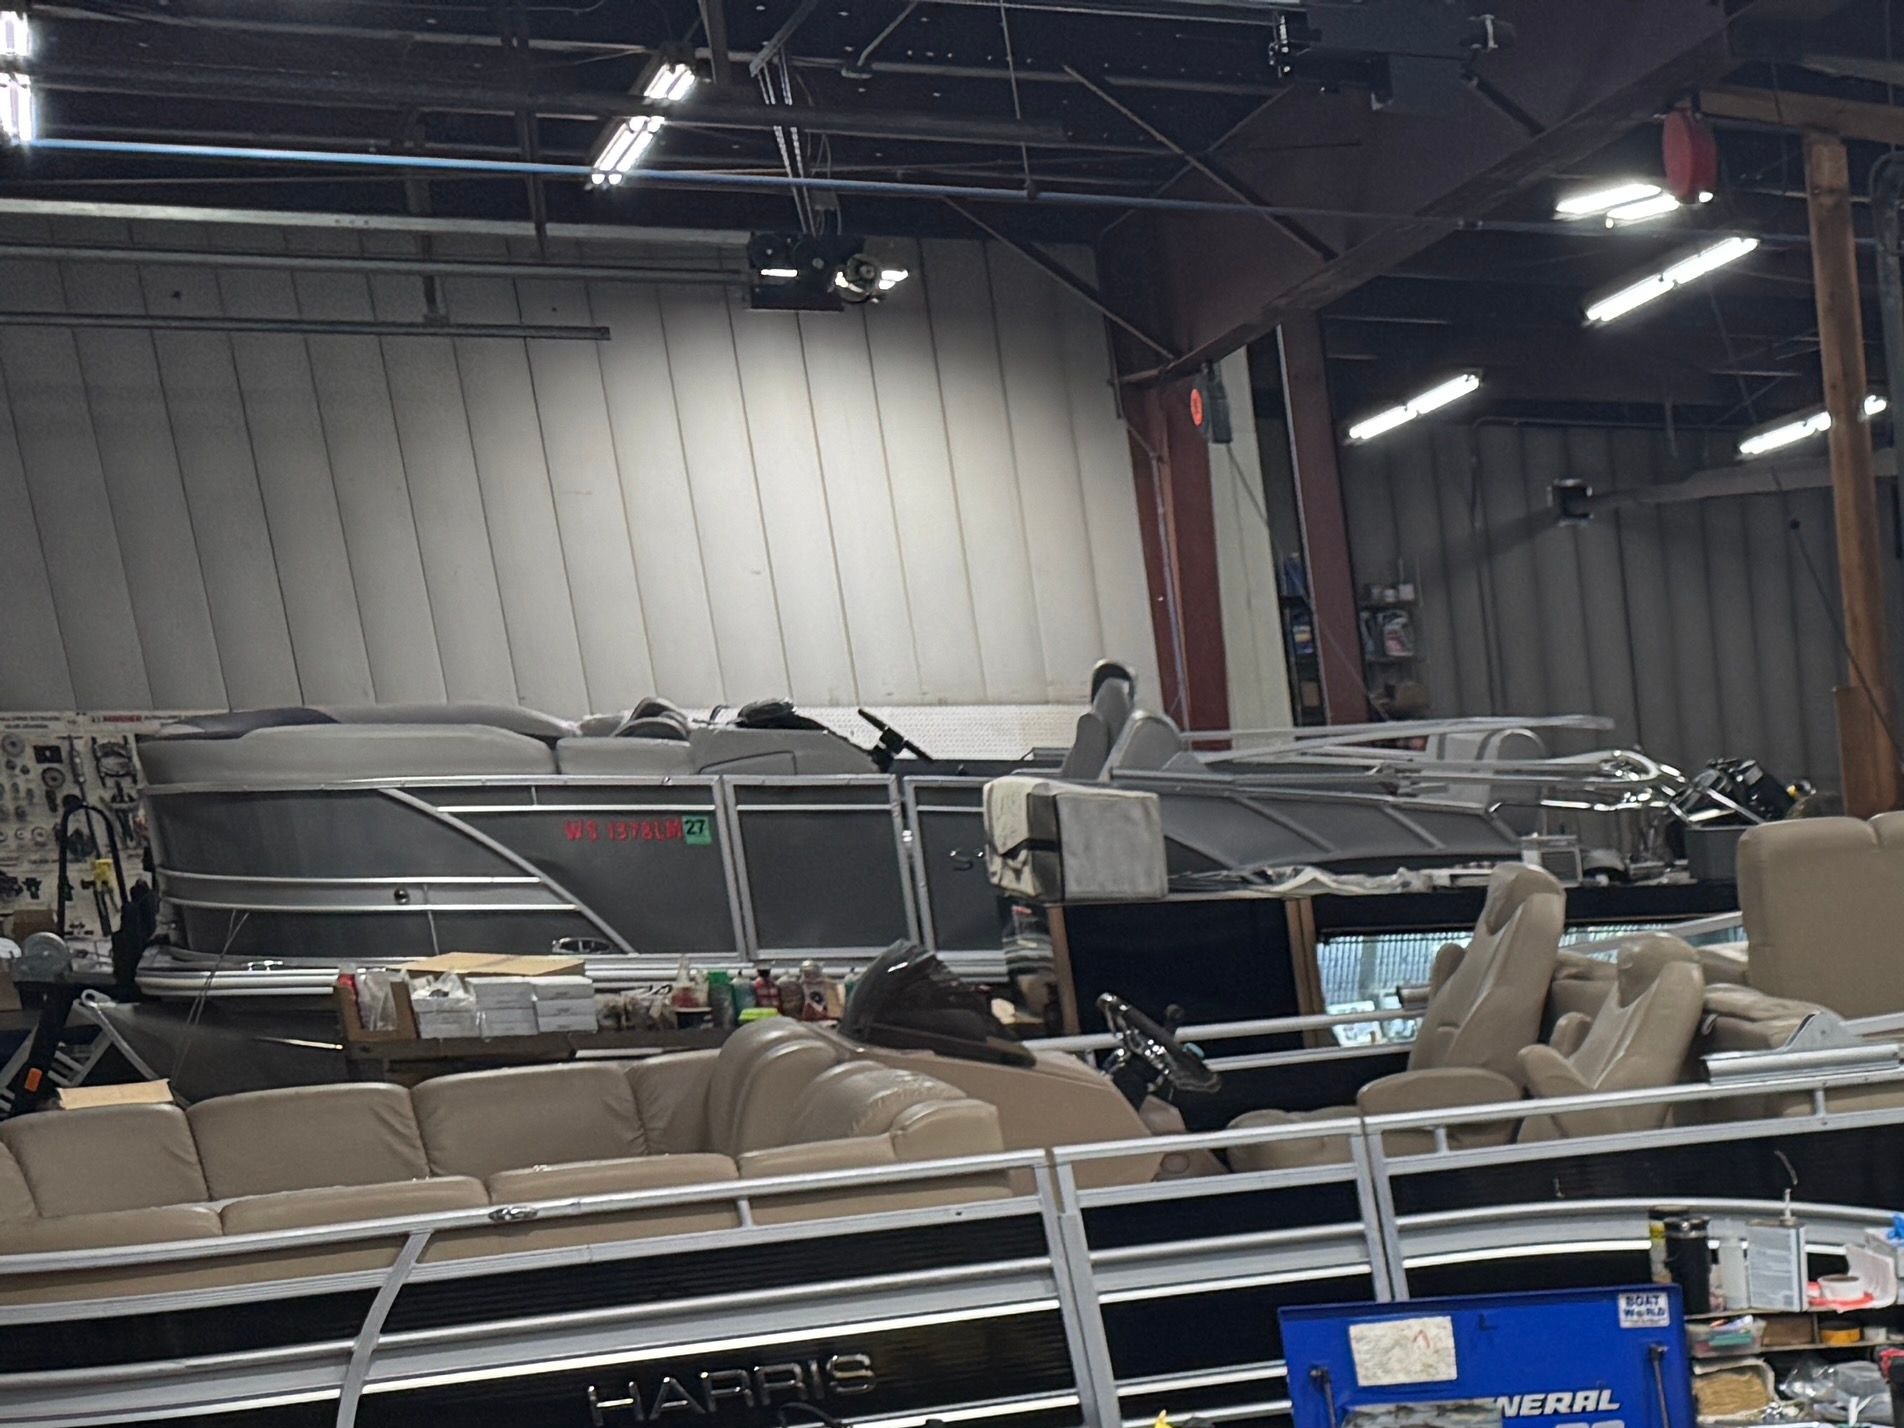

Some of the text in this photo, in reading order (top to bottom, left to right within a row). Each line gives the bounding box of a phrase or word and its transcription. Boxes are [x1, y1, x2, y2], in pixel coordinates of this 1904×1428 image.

[684, 819, 706, 835] 27
[1625, 1294, 1660, 1306] BOAT
[588, 1353, 876, 1426] HARRIS
[1494, 1389, 1620, 1417] NERAL
